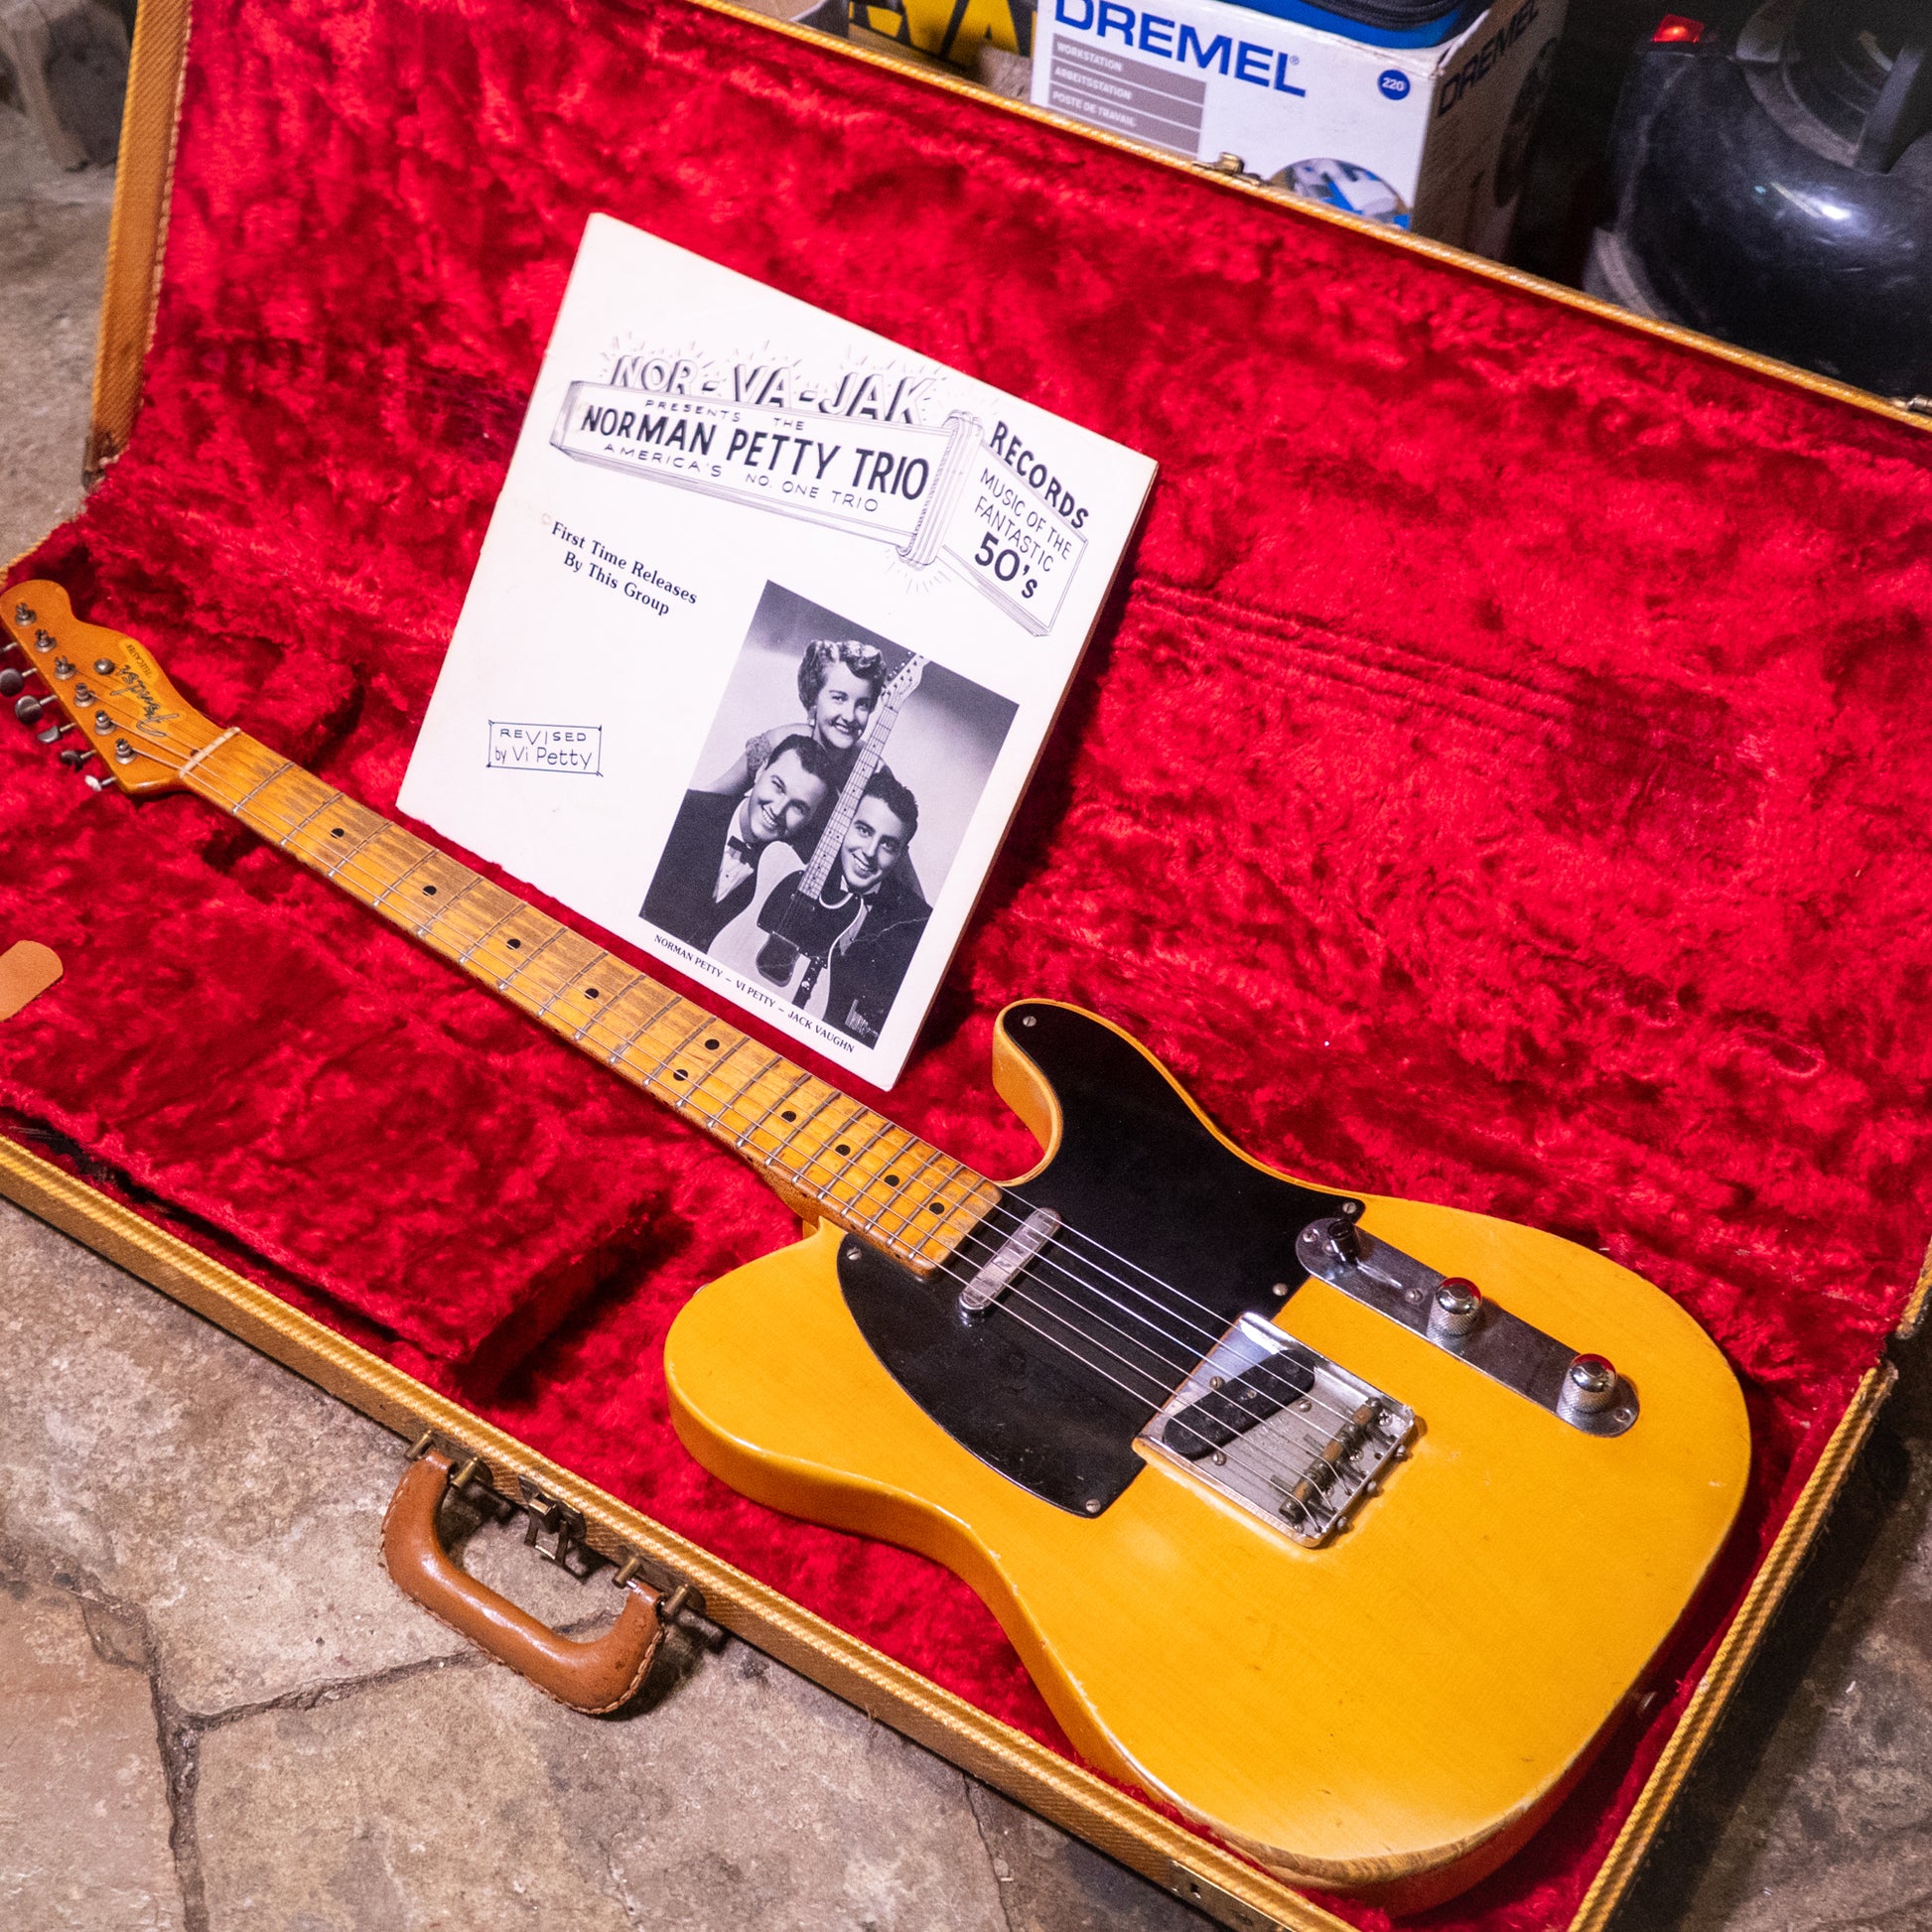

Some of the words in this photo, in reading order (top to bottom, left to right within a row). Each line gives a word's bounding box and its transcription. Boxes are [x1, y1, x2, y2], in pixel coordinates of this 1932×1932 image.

[1054, 67, 1133, 100] ARBEITSSTATION
[1056, 42, 1123, 72] WORKSTATION
[1381, 76, 1405, 91] 220
[1052, 90, 1082, 110] POSTE
[1083, 99, 1098, 115] DE
[1098, 104, 1137, 127] TRAVAIL
[646, 399, 742, 422] PRESENTS
[772, 417, 804, 431] THE
[581, 405, 717, 456] NORMAN
[726, 428, 841, 480] PETTY
[852, 448, 929, 500] TRIO
[604, 444, 722, 478] AMERICA'S
[746, 474, 772, 488] NO.
[782, 482, 819, 498] ONE
[831, 490, 879, 512] TRIO
[990, 420, 1088, 529] RECORDS
[975, 495, 1054, 572] FANTASTIC
[980, 468, 1026, 517] MUSIC
[1026, 511, 1046, 533] OF
[1047, 527, 1072, 560] THE
[552, 521, 586, 549] First
[591, 540, 627, 569] Time
[631, 561, 697, 604] Releases
[564, 551, 583, 573] By
[588, 563, 619, 589] This
[623, 582, 669, 617] Group
[110, 664, 180, 737] Fender
[494, 747, 507, 764] by
[512, 746, 529, 761] Vi
[536, 747, 593, 770] Petty
[499, 728, 587, 745] REVISED
[654, 934, 693, 963] NORMAN
[694, 958, 723, 978] PETTY
[736, 980, 747, 992] VI
[747, 987, 776, 1008] PETTY
[787, 1009, 813, 1031] JACK
[814, 1025, 856, 1053] VAUGHN
